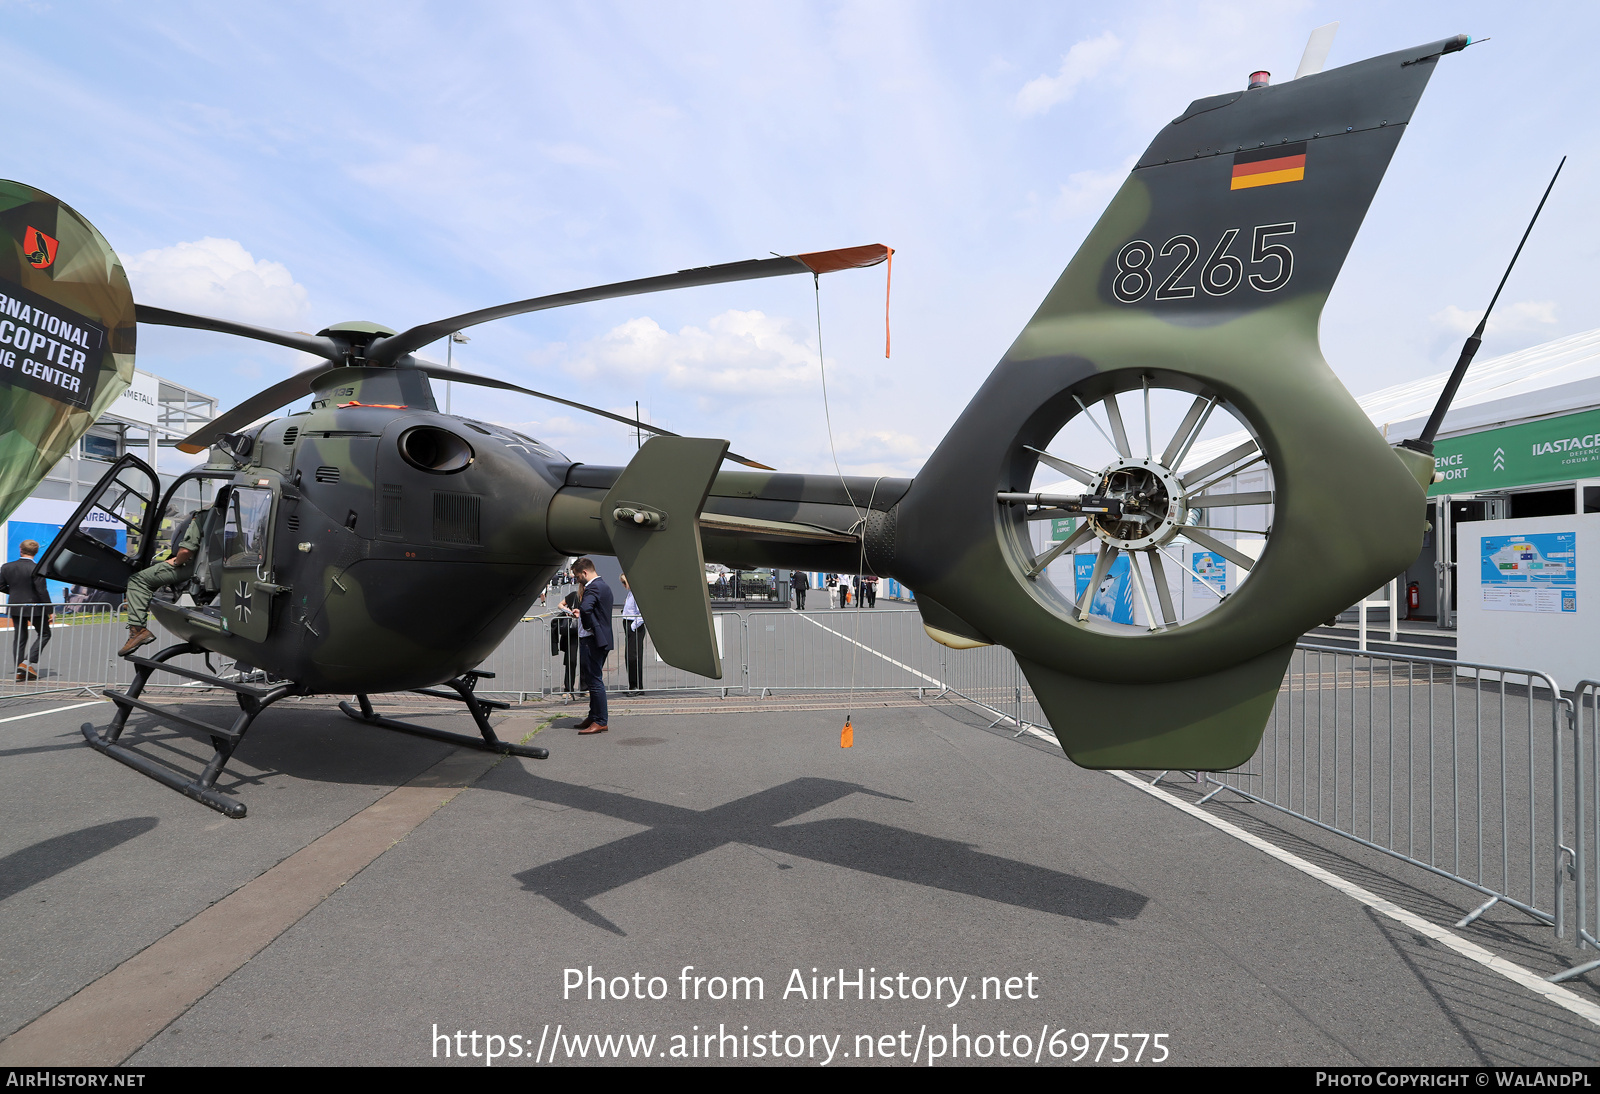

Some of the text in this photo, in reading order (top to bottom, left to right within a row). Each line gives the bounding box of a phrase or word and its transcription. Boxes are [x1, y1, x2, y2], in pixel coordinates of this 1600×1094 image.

[1112, 222, 1296, 303] 8265
[0, 320, 86, 373] COPTER
[21, 358, 81, 393] CENTER
[1434, 454, 1463, 468] ENCE
[1561, 457, 1588, 465] FORUM
